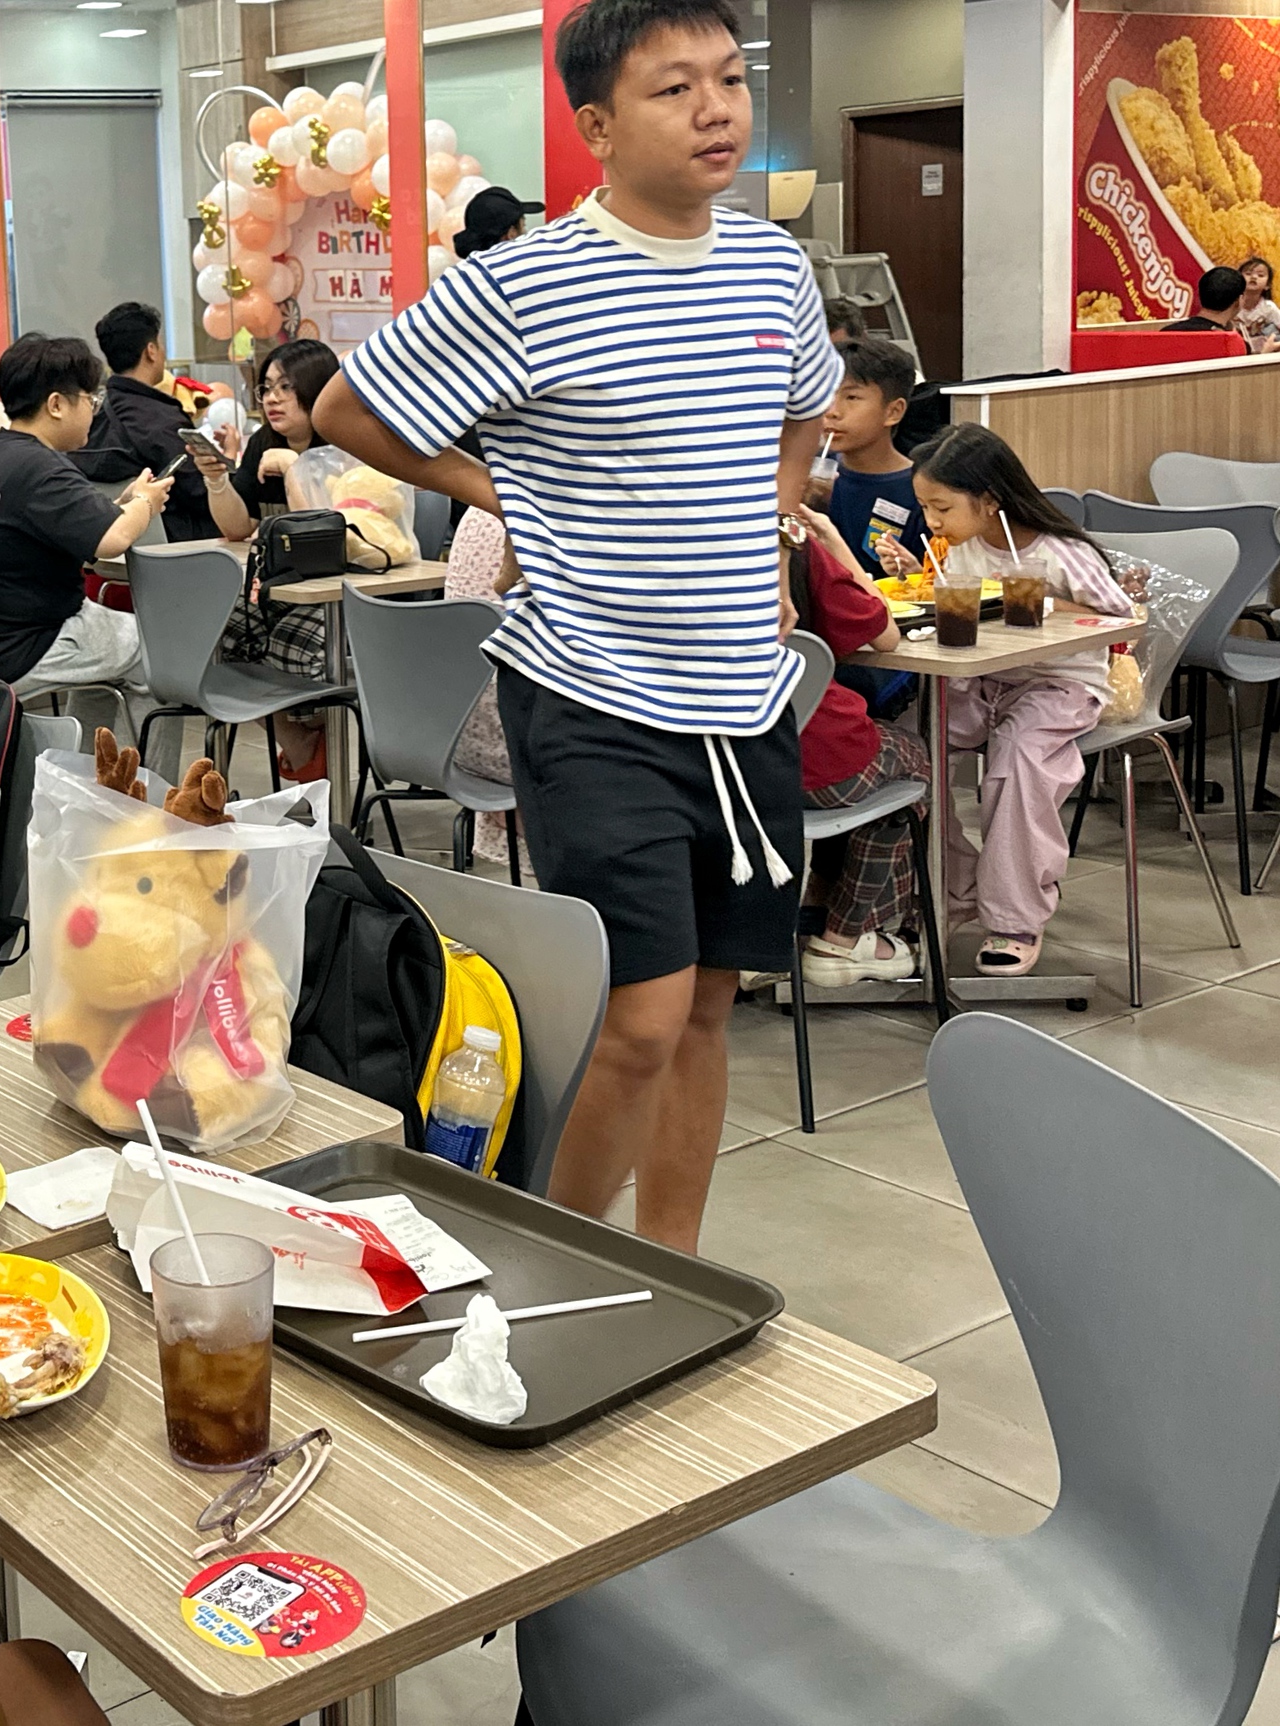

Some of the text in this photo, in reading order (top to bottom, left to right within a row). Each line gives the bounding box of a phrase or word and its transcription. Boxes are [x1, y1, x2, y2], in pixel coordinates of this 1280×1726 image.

[1077, 204, 1131, 277] rispylicious!
[1090, 168, 1189, 319] Chickenjoy
[329, 272, 363, 298] HÀ
[213, 978, 249, 1061] Jollibe
[168, 1160, 246, 1185] Jollibe
[308, 1563, 345, 1582] APP
[198, 1605, 254, 1646] Giao Hàng
